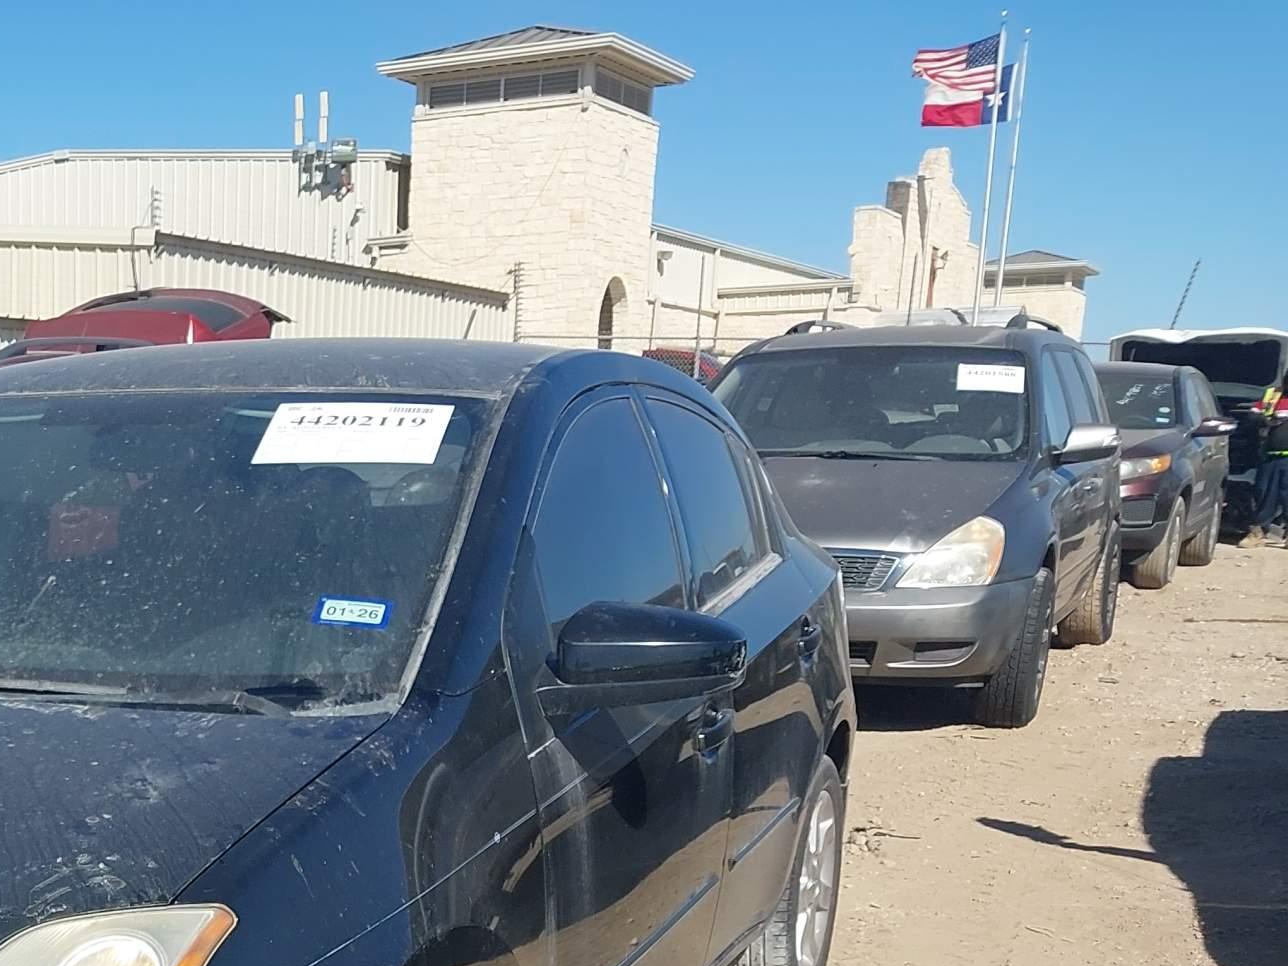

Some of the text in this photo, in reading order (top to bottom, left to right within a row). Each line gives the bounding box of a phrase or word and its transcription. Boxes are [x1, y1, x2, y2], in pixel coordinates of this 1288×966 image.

[290, 416, 426, 426] 44202119
[326, 606, 379, 619] 01 26
